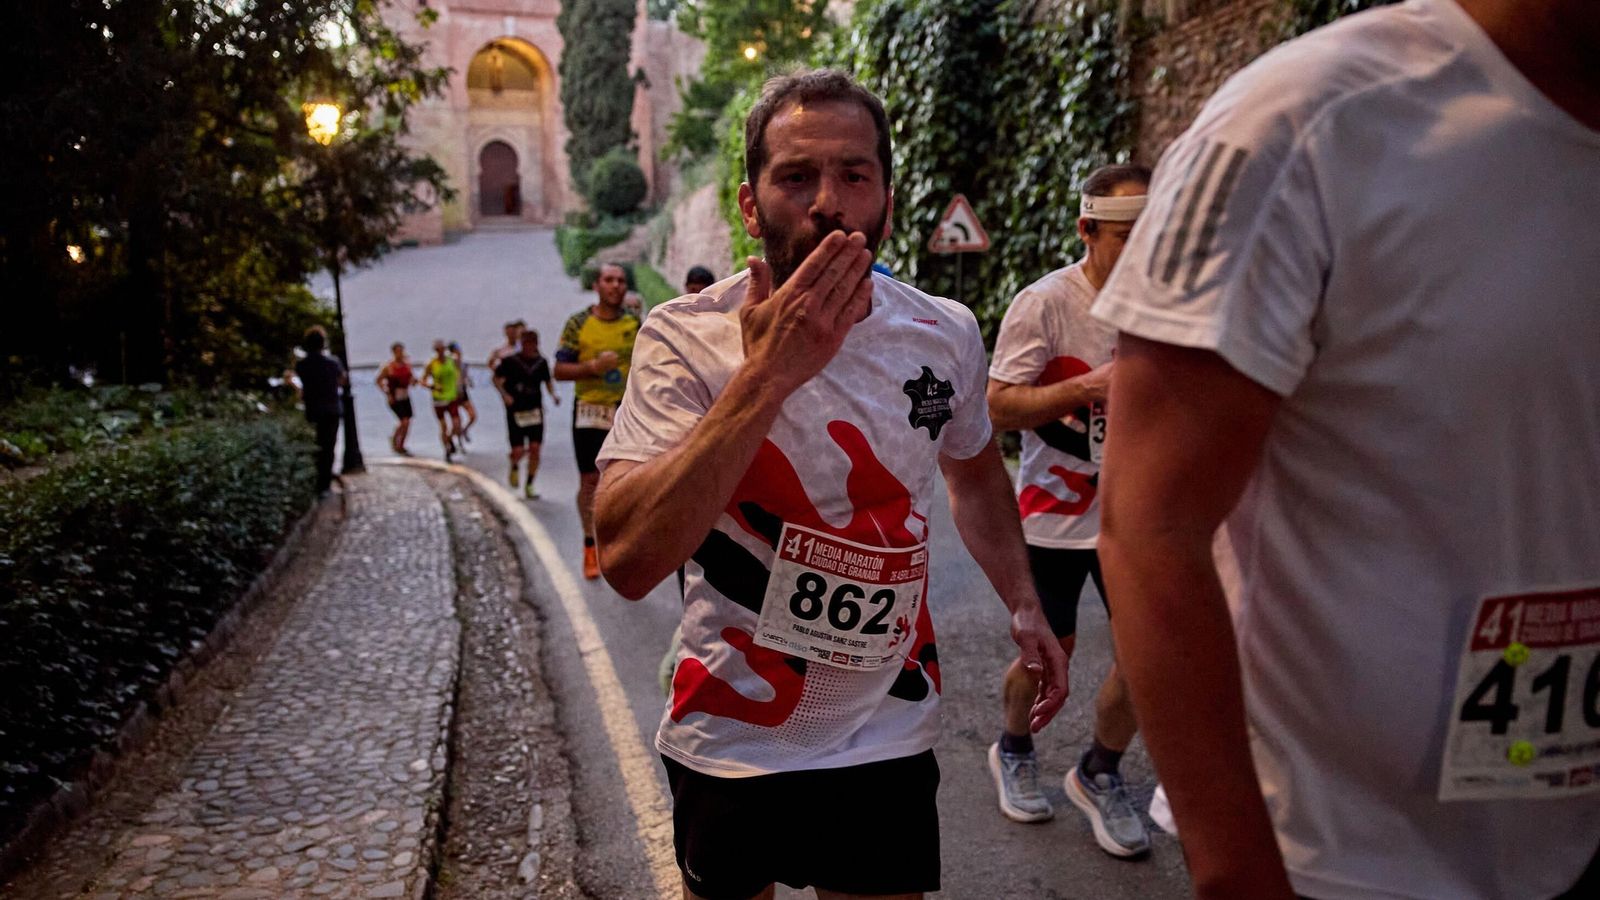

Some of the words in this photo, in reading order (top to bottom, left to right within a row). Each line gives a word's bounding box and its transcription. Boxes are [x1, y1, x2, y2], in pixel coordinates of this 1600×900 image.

[785, 533, 815, 562] 41
[814, 541, 842, 561] MEDIA
[843, 549, 885, 571] MARATÓN
[810, 554, 837, 571] CIUDAD
[838, 562, 849, 575] DE
[848, 566, 880, 581] GRANADA
[789, 572, 896, 634] 862
[792, 623, 811, 637] PABLO
[833, 635, 847, 646] SANZ
[848, 639, 868, 649] SASTRE
[1480, 601, 1525, 645] 41
[809, 645, 832, 657] POWER
